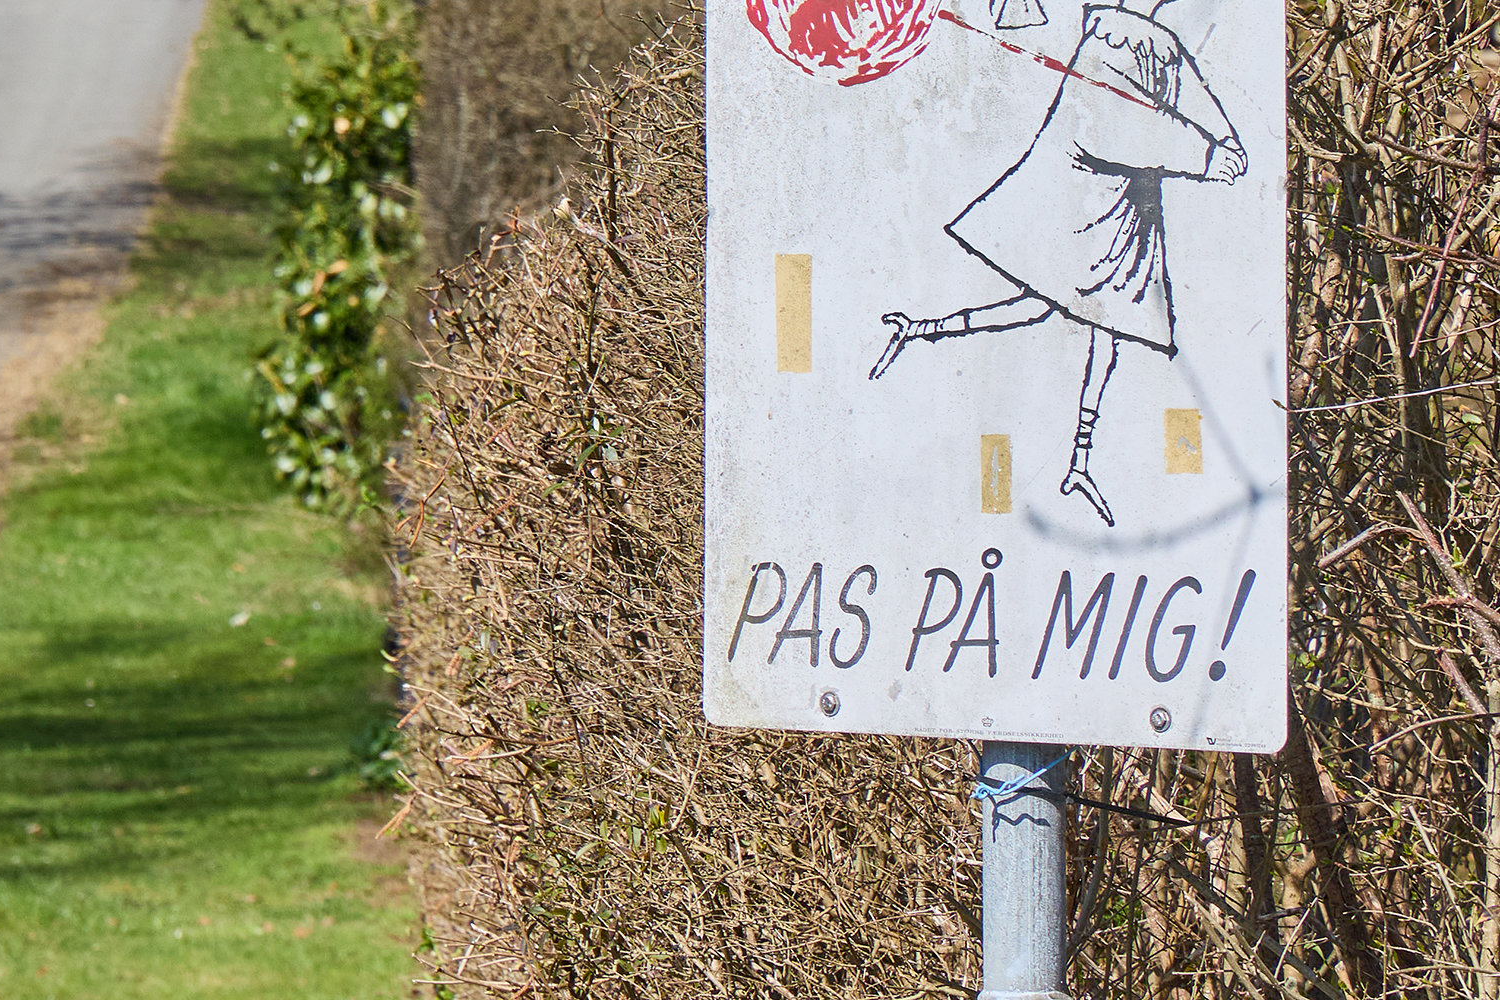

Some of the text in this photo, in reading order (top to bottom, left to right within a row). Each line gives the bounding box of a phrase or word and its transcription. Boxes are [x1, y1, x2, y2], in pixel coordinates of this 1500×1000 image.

[727, 547, 1257, 683] PAS PÅ MIG!
